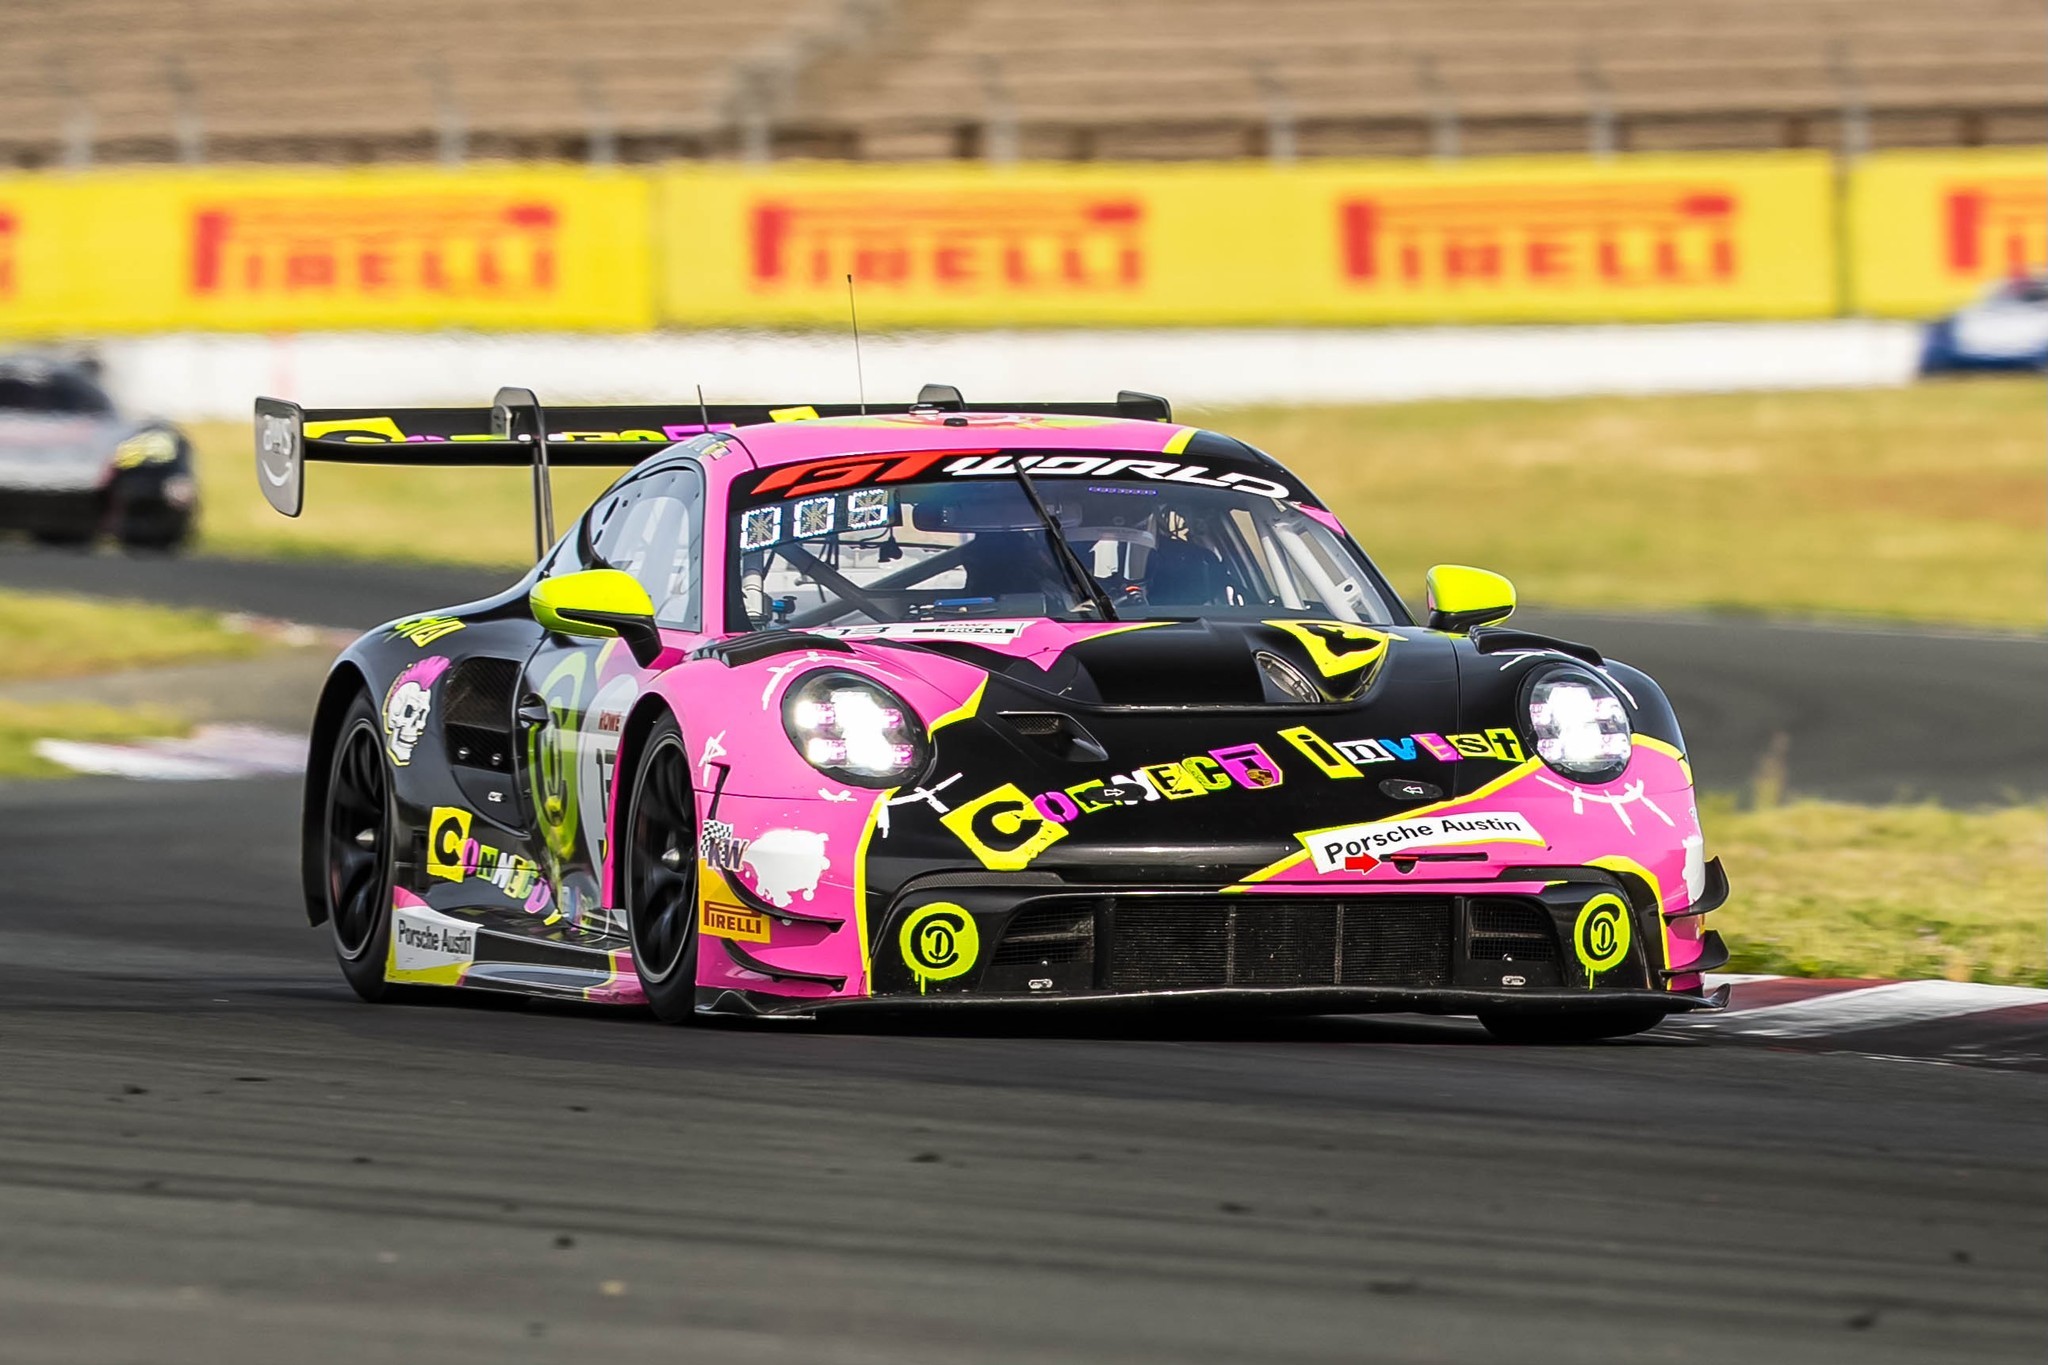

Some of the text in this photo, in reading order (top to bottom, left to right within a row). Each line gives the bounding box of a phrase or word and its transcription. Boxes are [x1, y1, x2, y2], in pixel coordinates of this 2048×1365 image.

[188, 199, 562, 294] PIRELLI
[748, 192, 1143, 290] PIRELLI
[1338, 188, 1738, 284] PIRELLI
[750, 449, 1290, 500] GT WORLD
[707, 838, 749, 871] KW
[1323, 817, 1521, 865] Porsche Austin
[398, 919, 472, 955] Porsche Austin
[704, 900, 763, 934] PIRELLI
